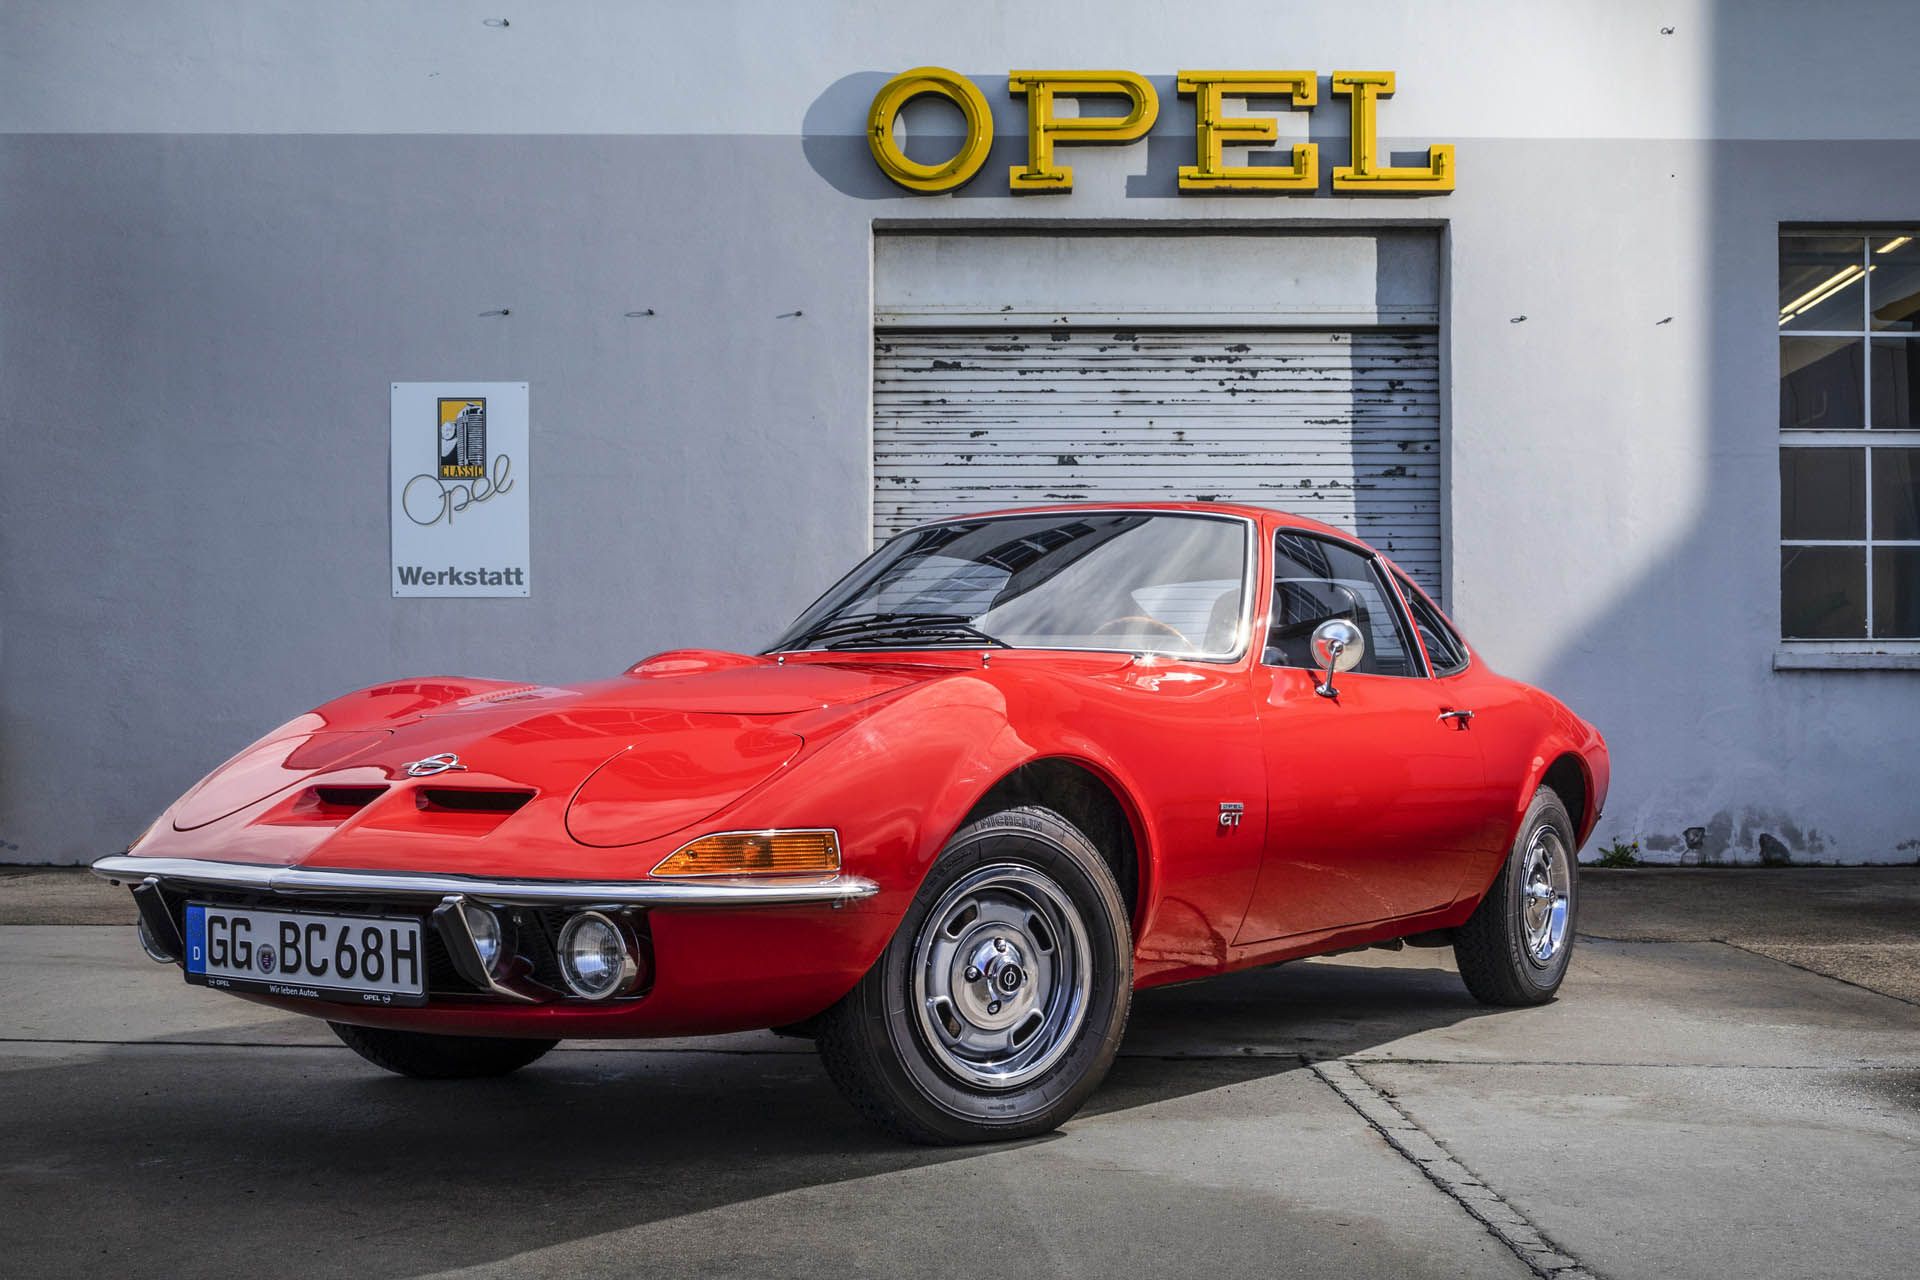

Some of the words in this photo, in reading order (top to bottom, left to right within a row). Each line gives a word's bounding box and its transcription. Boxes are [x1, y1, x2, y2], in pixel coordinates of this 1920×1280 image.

[867, 66, 1455, 196] OPEL
[442, 465, 483, 477] CLASSIC
[403, 454, 513, 525] Opel
[397, 566, 524, 586] Werkstatt
[980, 816, 1042, 831] MICHELIN
[1220, 812, 1243, 826] GT
[208, 915, 252, 970] GG
[194, 946, 200, 960] D
[281, 986, 298, 995] leben
